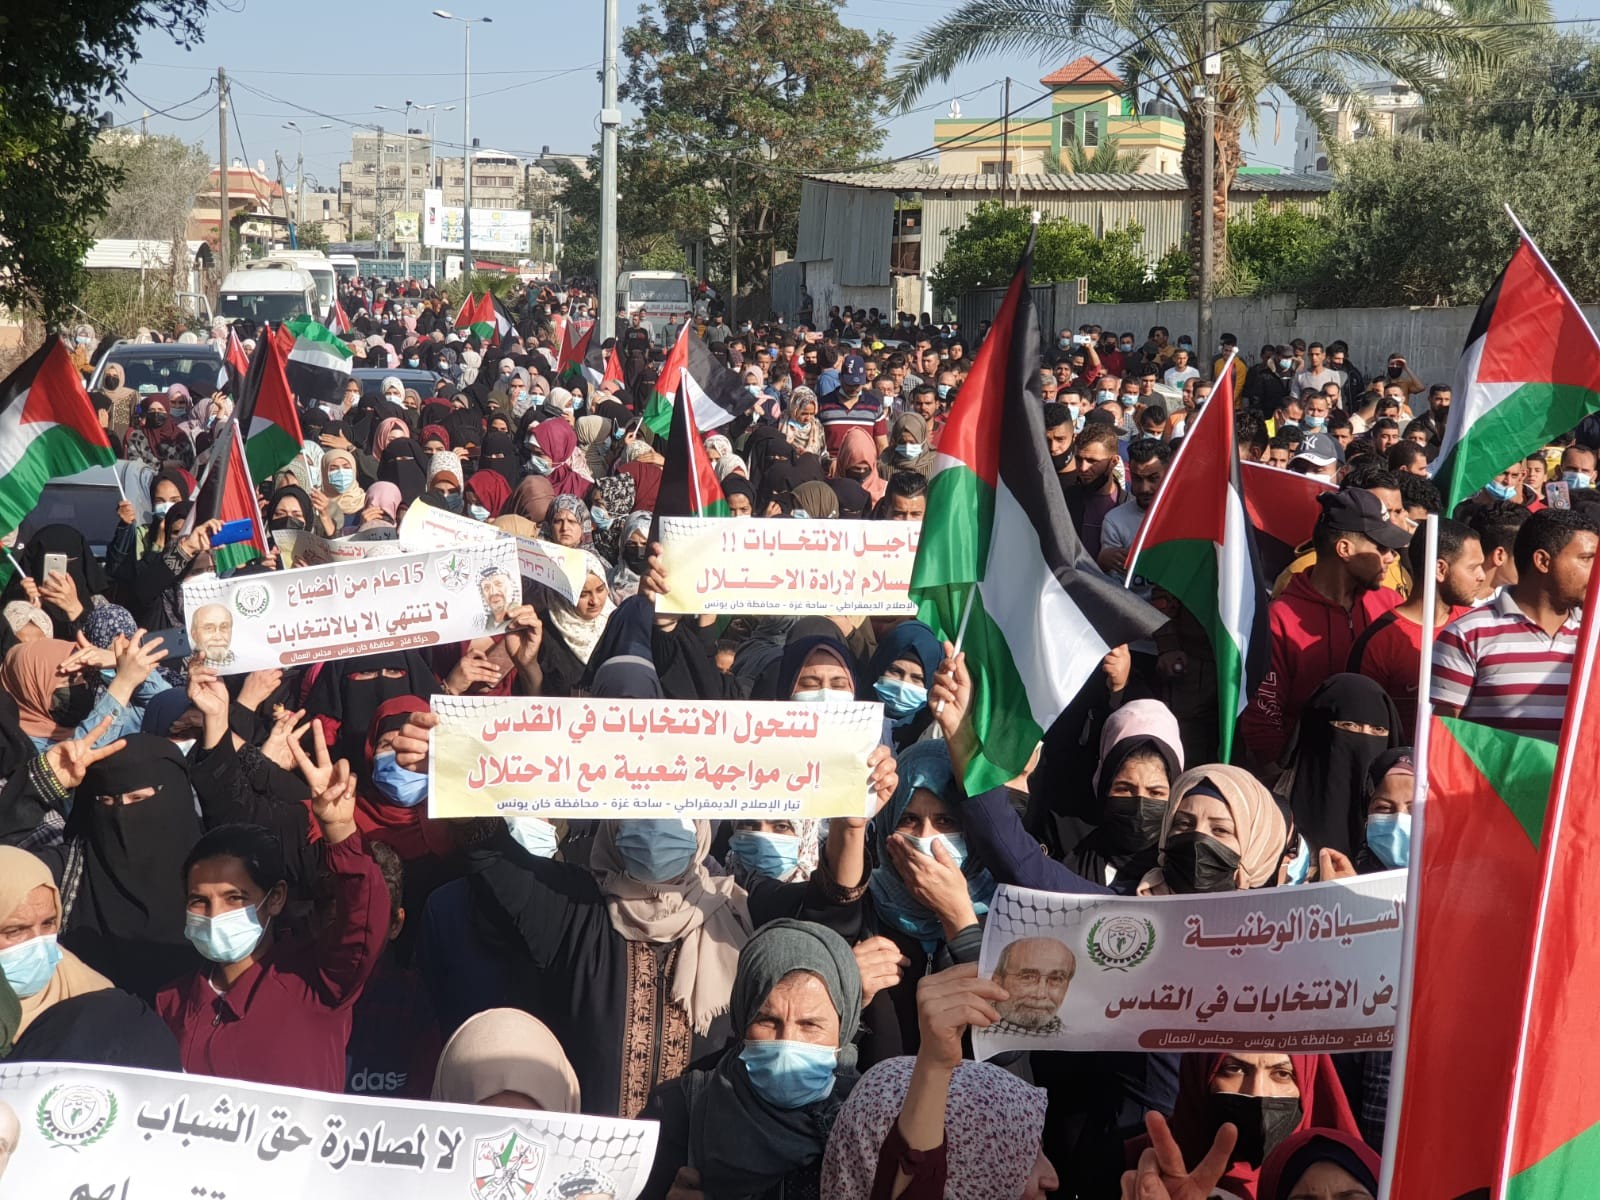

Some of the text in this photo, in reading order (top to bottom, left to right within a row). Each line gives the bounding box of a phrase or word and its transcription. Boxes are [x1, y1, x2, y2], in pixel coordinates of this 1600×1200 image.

[743, 528, 848, 557] الانتخابات
[696, 567, 805, 593] الاحتلال
[861, 569, 910, 598] سلام
[287, 576, 338, 607] الضياع
[344, 577, 368, 599] من
[436, 601, 449, 620] لا
[704, 600, 727, 609] يونس
[730, 600, 744, 609] خان
[746, 600, 780, 608] محافظة
[788, 601, 803, 611] غزة
[805, 600, 828, 609] ساحة
[836, 601, 884, 613] الديمقراطي
[386, 603, 433, 636] تنتهي
[266, 614, 358, 647] بالانتخابات
[290, 634, 429, 662] حركة فتح محافظة خان يونس مجلس العمال
[481, 704, 819, 744] لتتحول الانتخابات في القدس
[468, 754, 820, 792] إلى مواجهة شعبية مع الاحتلال
[497, 799, 528, 811] يونس
[532, 799, 550, 811] خان
[554, 798, 599, 809] محافظة
[611, 799, 629, 811] غزة
[633, 799, 662, 809] ساحة
[674, 799, 737, 813] الديمقراطي
[741, 800, 780, 812] الإصلاح
[784, 800, 800, 812] تيار
[1185, 909, 1303, 956] الوطنية
[1105, 984, 1194, 1019] القدس
[1196, 984, 1229, 1023] في
[1233, 978, 1358, 1021] الانتخابات
[1159, 1032, 1196, 1046] العمال
[1199, 1034, 1233, 1046] مجلس
[1245, 1036, 1275, 1048] يونس
[1278, 1034, 1297, 1048] خان
[1301, 1034, 1344, 1046] محافظة
[1354, 1033, 1373, 1046] فتح
[1376, 1029, 1394, 1044] ركة
[137, 1098, 462, 1170] لا لمصادرة حق الشباب
